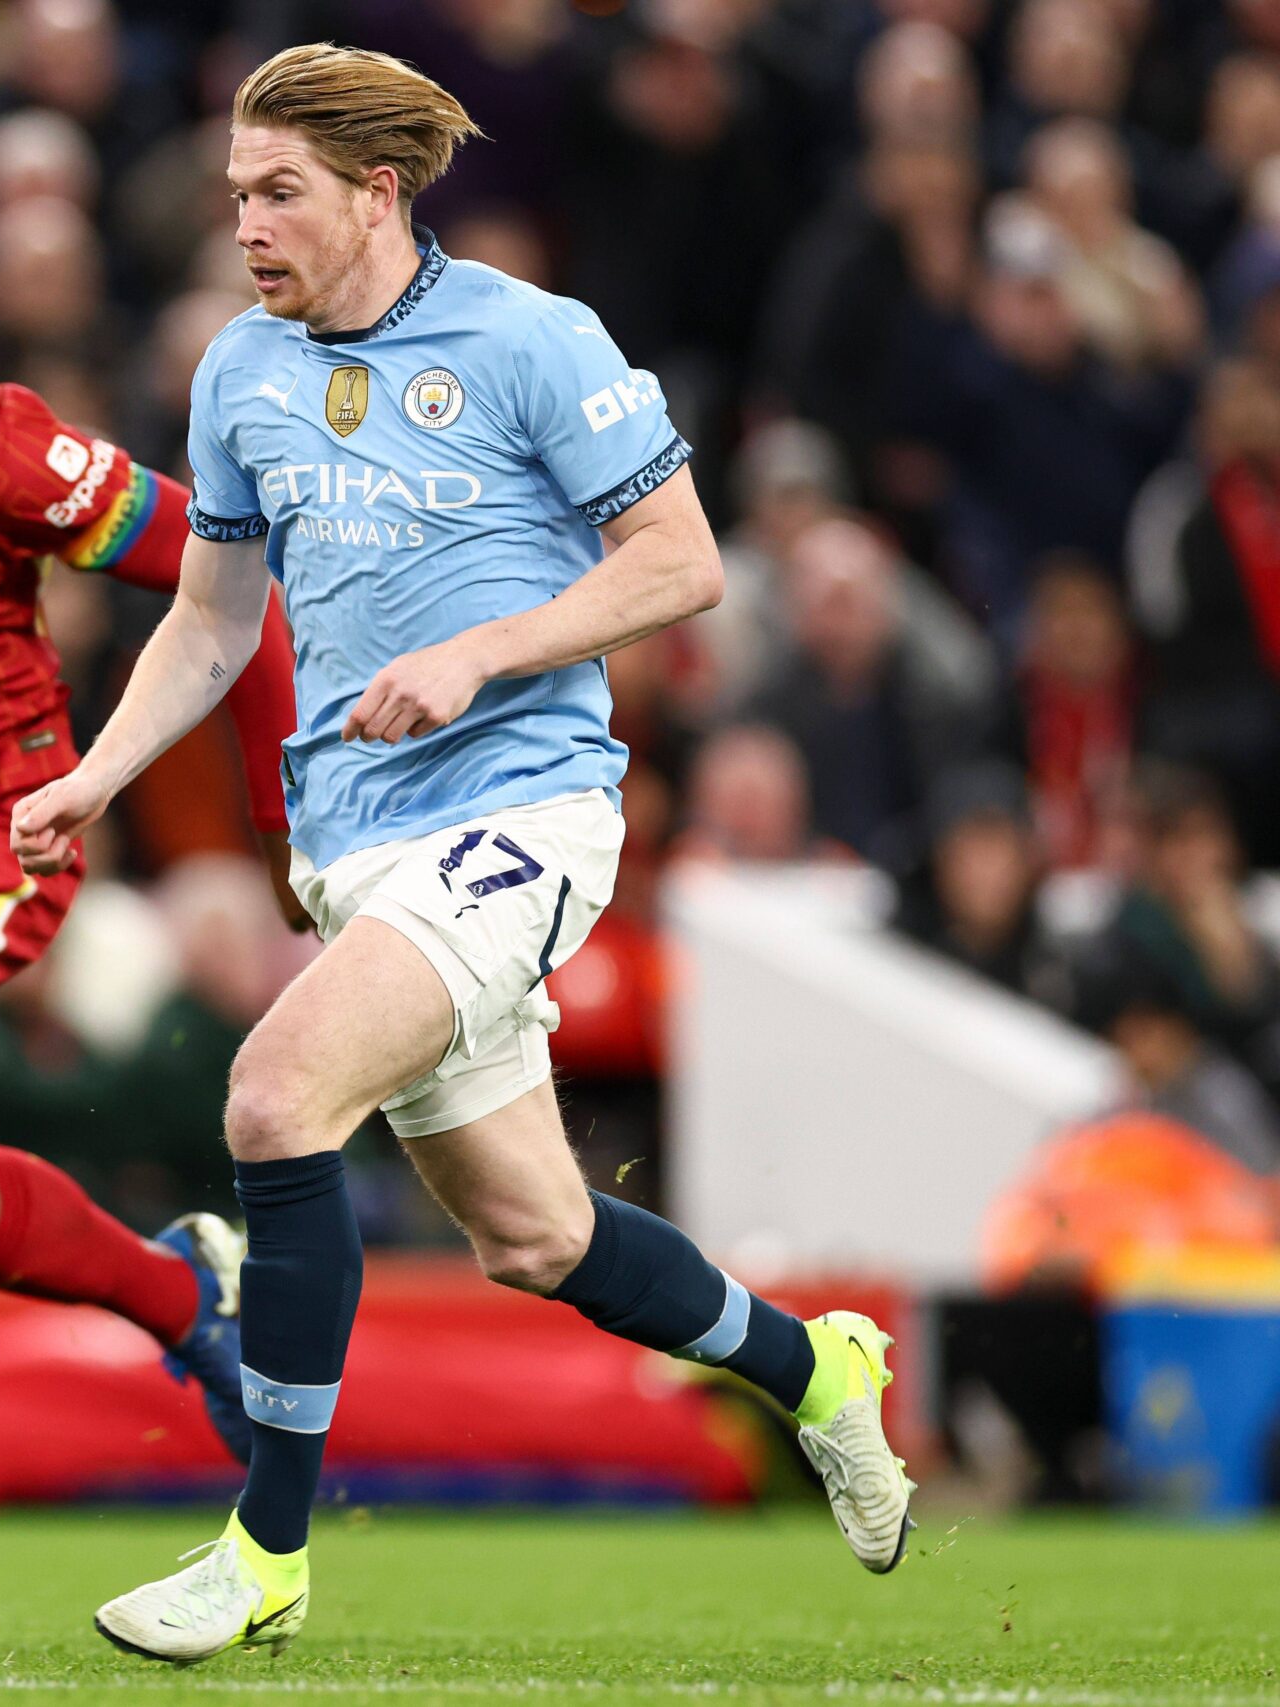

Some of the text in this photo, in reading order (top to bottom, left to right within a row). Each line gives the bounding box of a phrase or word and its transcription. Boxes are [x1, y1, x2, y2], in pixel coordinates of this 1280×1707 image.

[410, 372, 459, 392] MANCHESTER
[336, 410, 355, 420] FIFA
[262, 463, 482, 509] ETIHAD
[296, 514, 425, 548] AIRWAYS
[438, 829, 545, 899] 17
